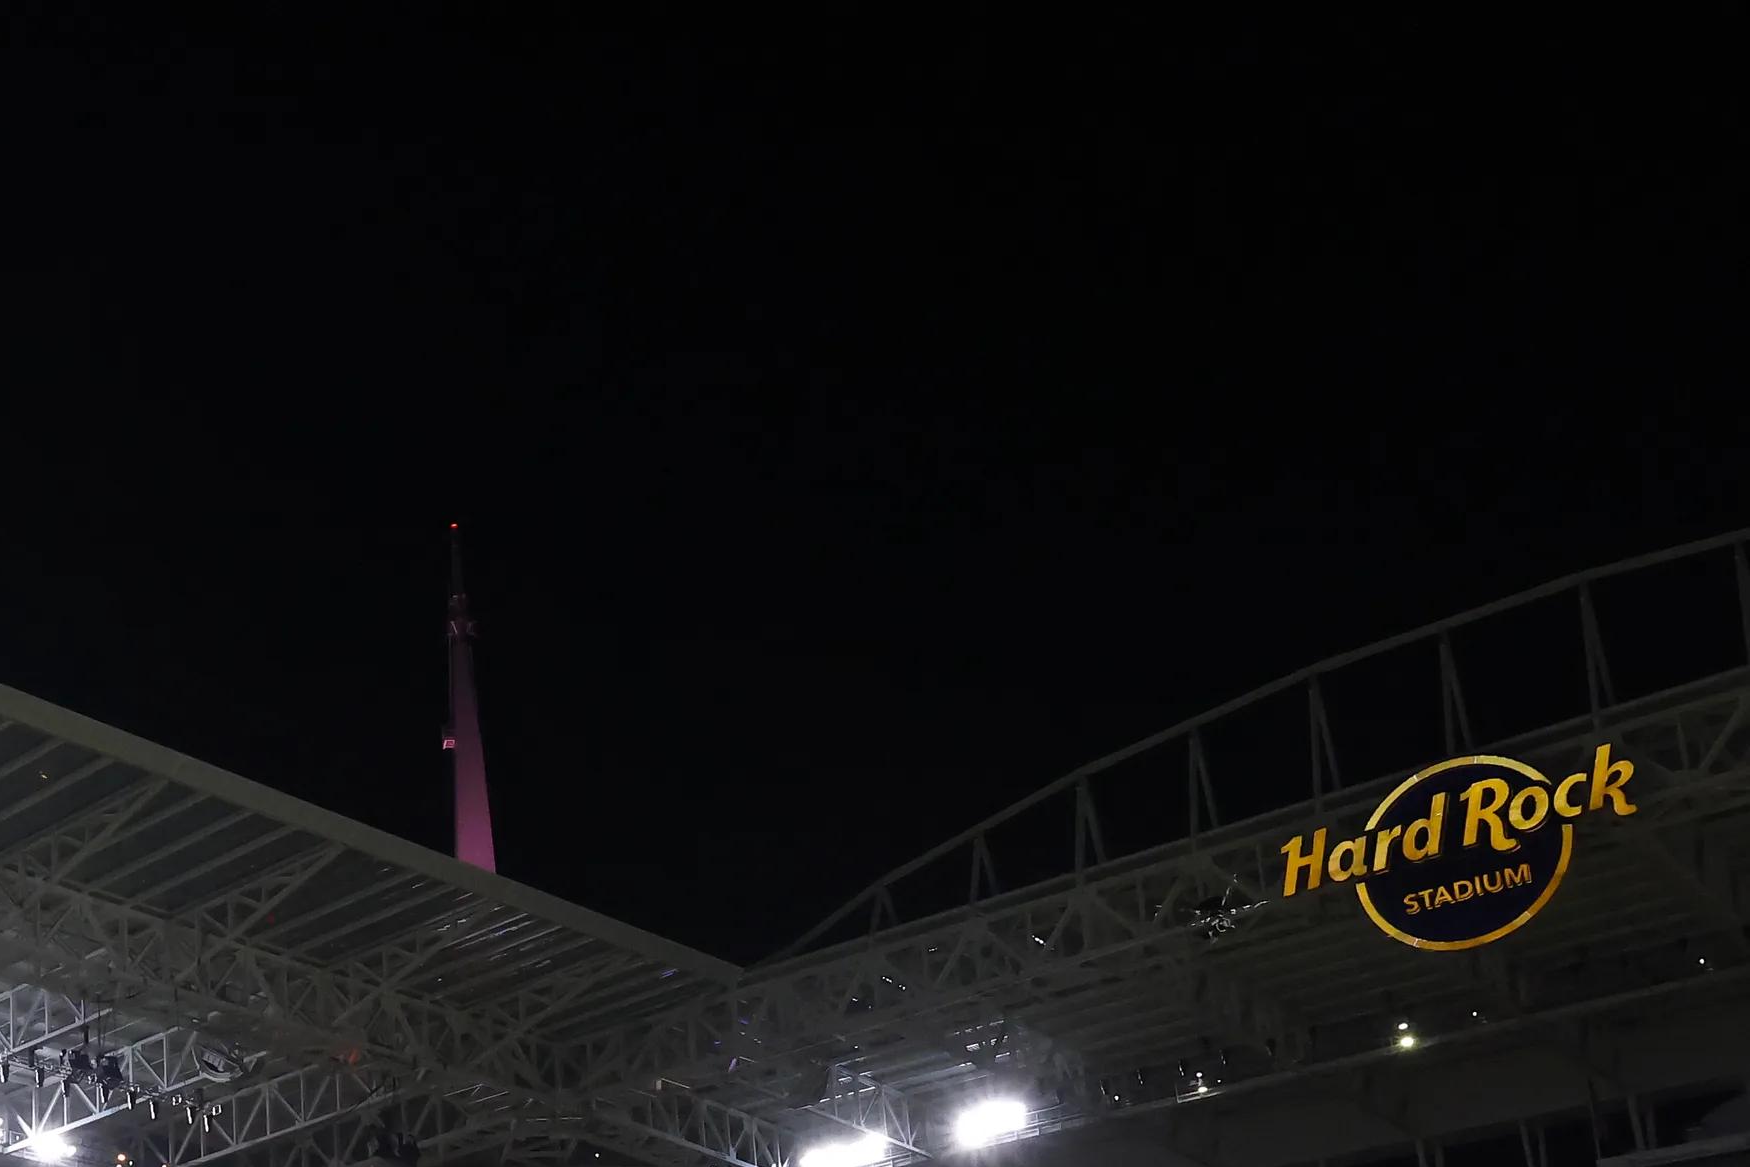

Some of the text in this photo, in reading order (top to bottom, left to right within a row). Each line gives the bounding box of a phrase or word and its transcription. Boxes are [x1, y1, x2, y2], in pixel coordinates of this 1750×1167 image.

[1280, 742, 1638, 897] Hard Rock
[1403, 863, 1532, 915] STADIUM
